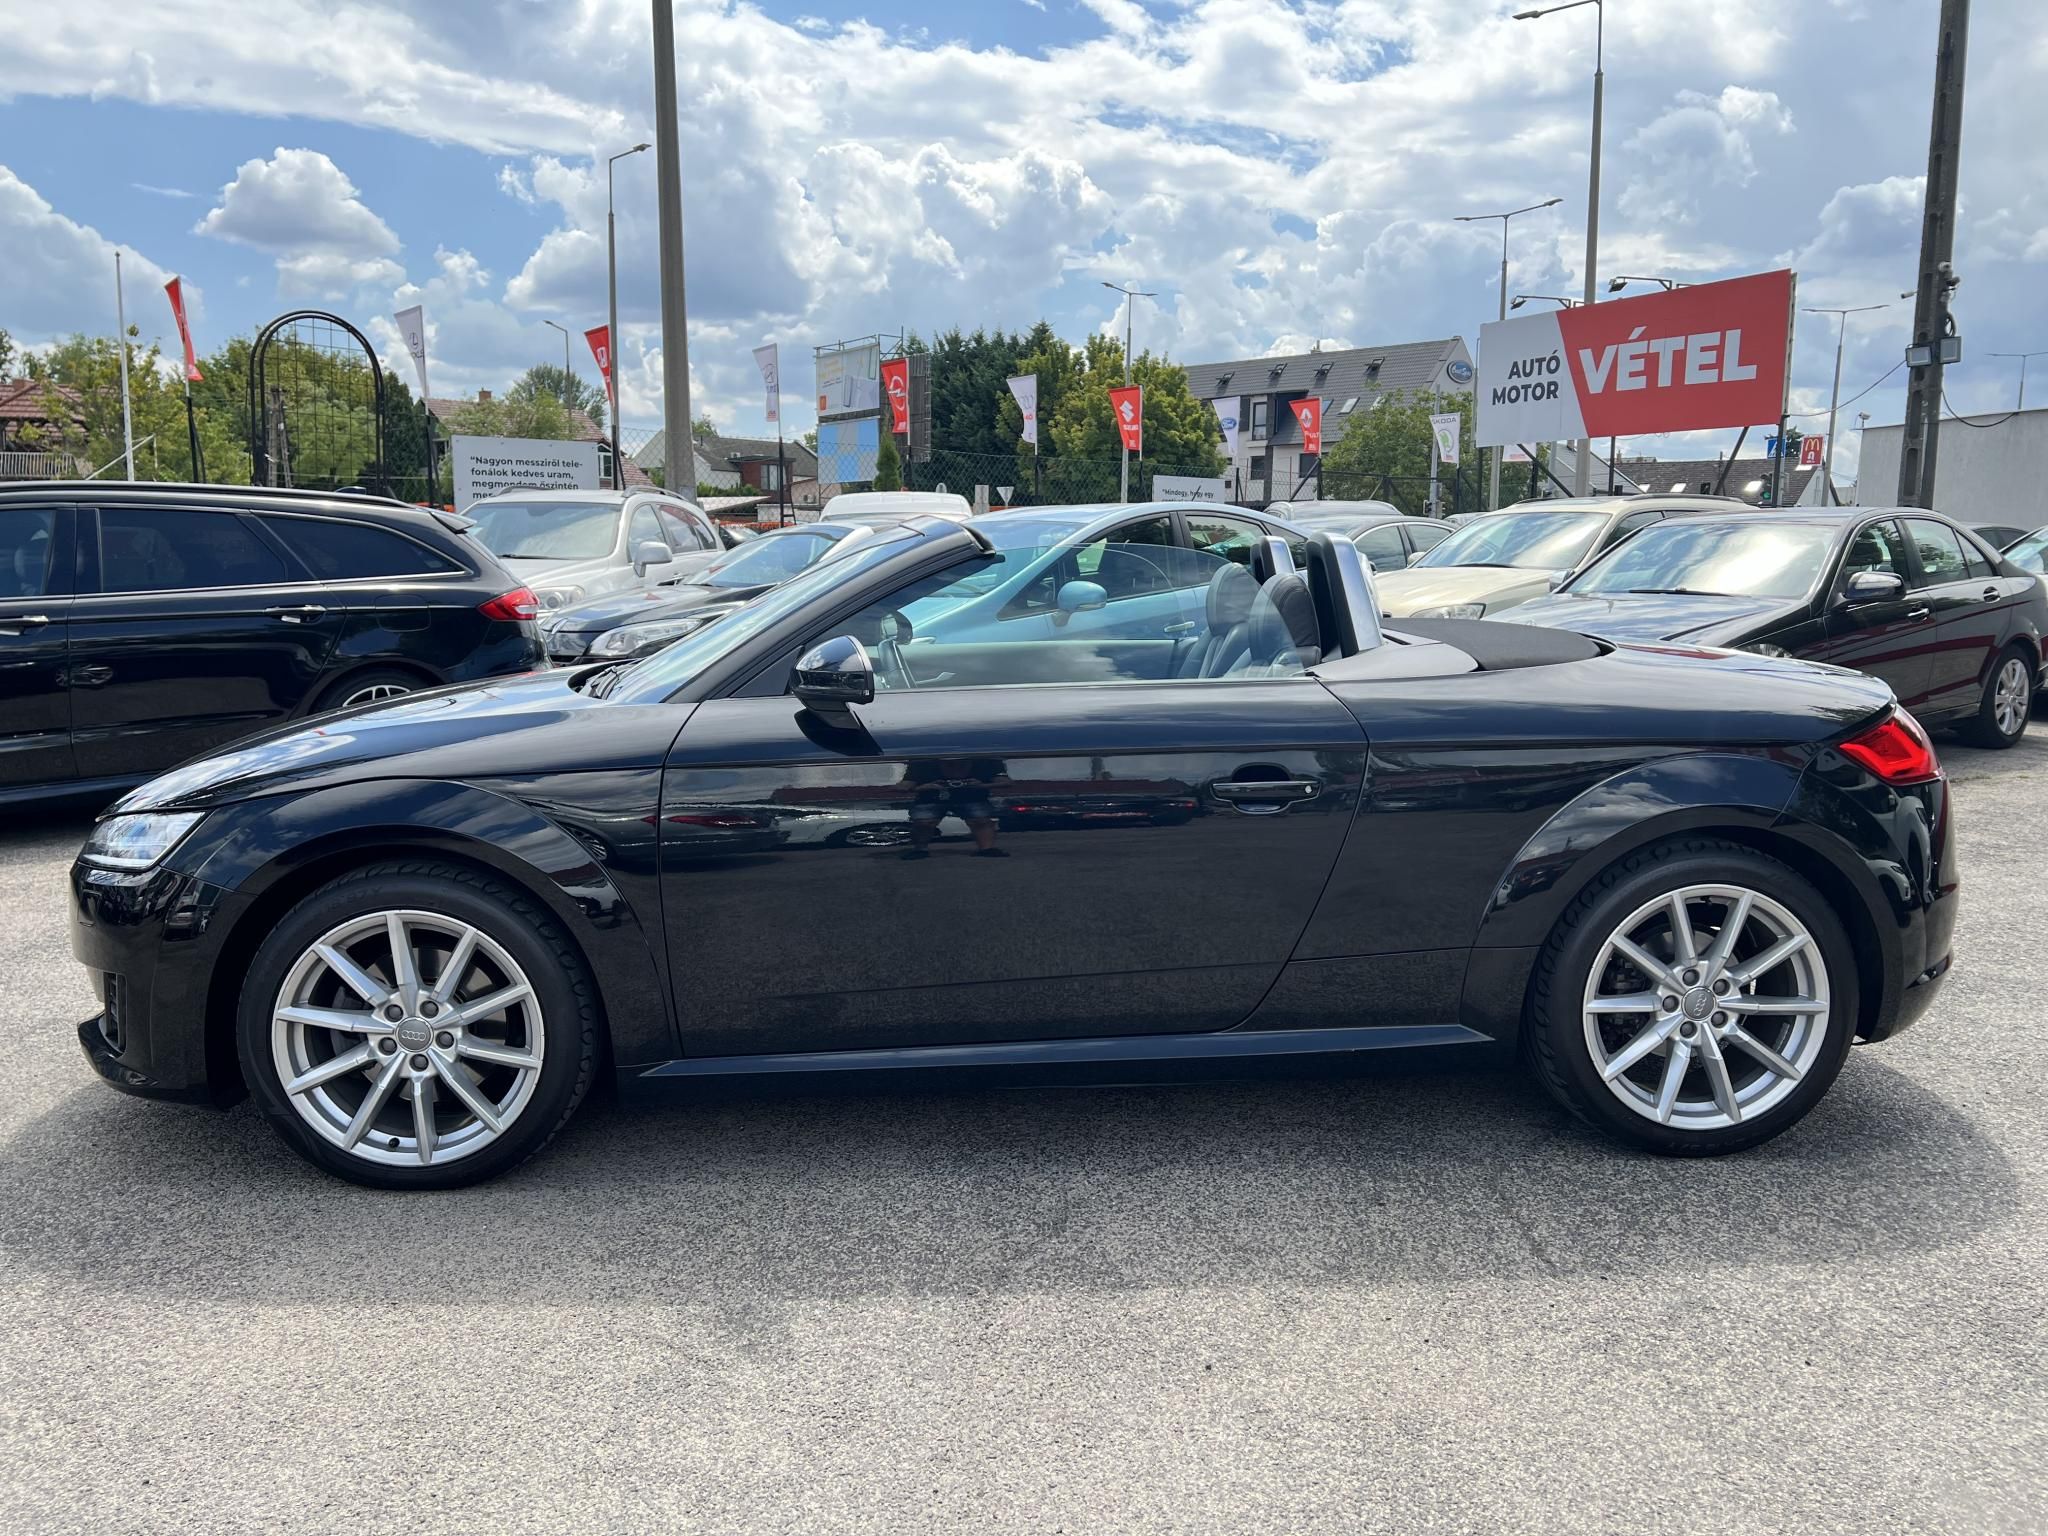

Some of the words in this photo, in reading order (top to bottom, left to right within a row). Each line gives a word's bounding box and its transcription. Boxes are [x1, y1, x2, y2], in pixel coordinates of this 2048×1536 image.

[1508, 349, 1561, 380] AUTÓ
[1578, 326, 1758, 395] VÉTEL
[1491, 380, 1560, 406] MOTOR
[471, 467, 508, 477] fonálok
[511, 469, 545, 478] kedves
[547, 472, 574, 480] uram,
[562, 460, 583, 468] tele-
